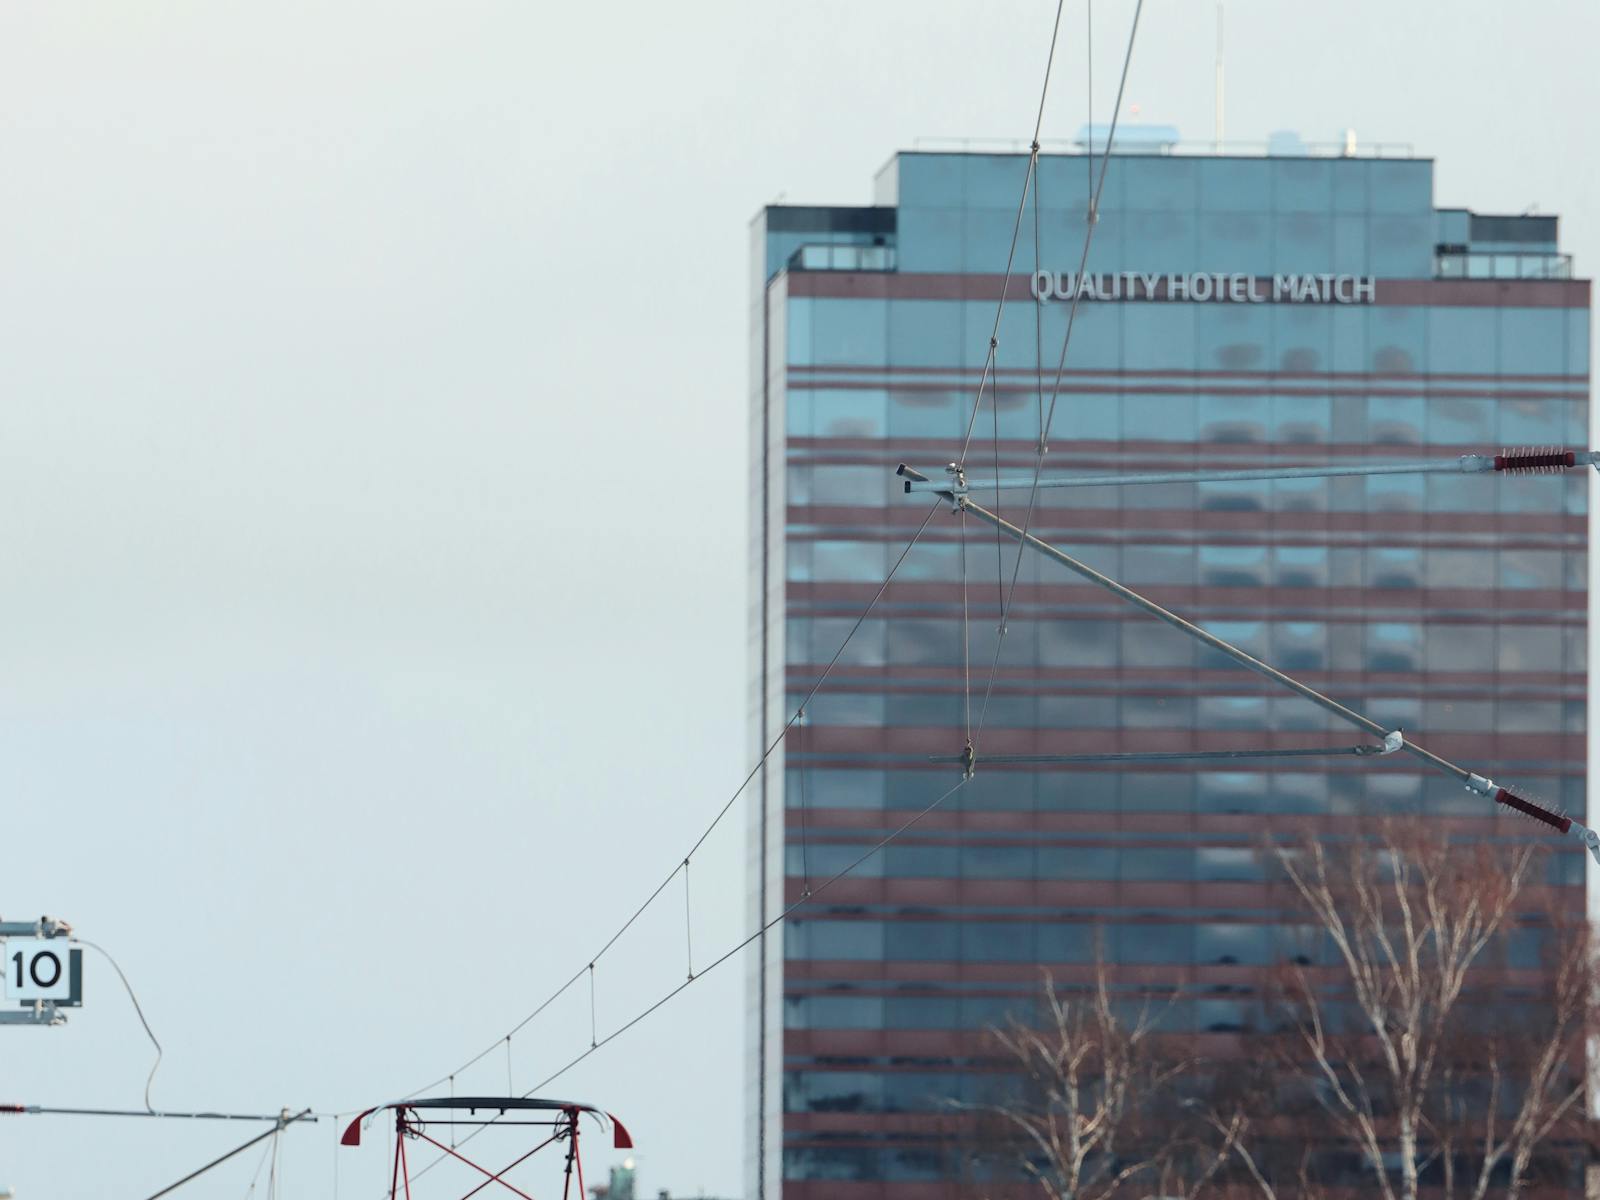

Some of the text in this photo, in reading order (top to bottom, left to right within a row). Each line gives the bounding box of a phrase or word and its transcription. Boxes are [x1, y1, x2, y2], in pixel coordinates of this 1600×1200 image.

[1031, 270, 1375, 305] QUALITY HOTEL MATCH
[12, 951, 61, 988] 10
